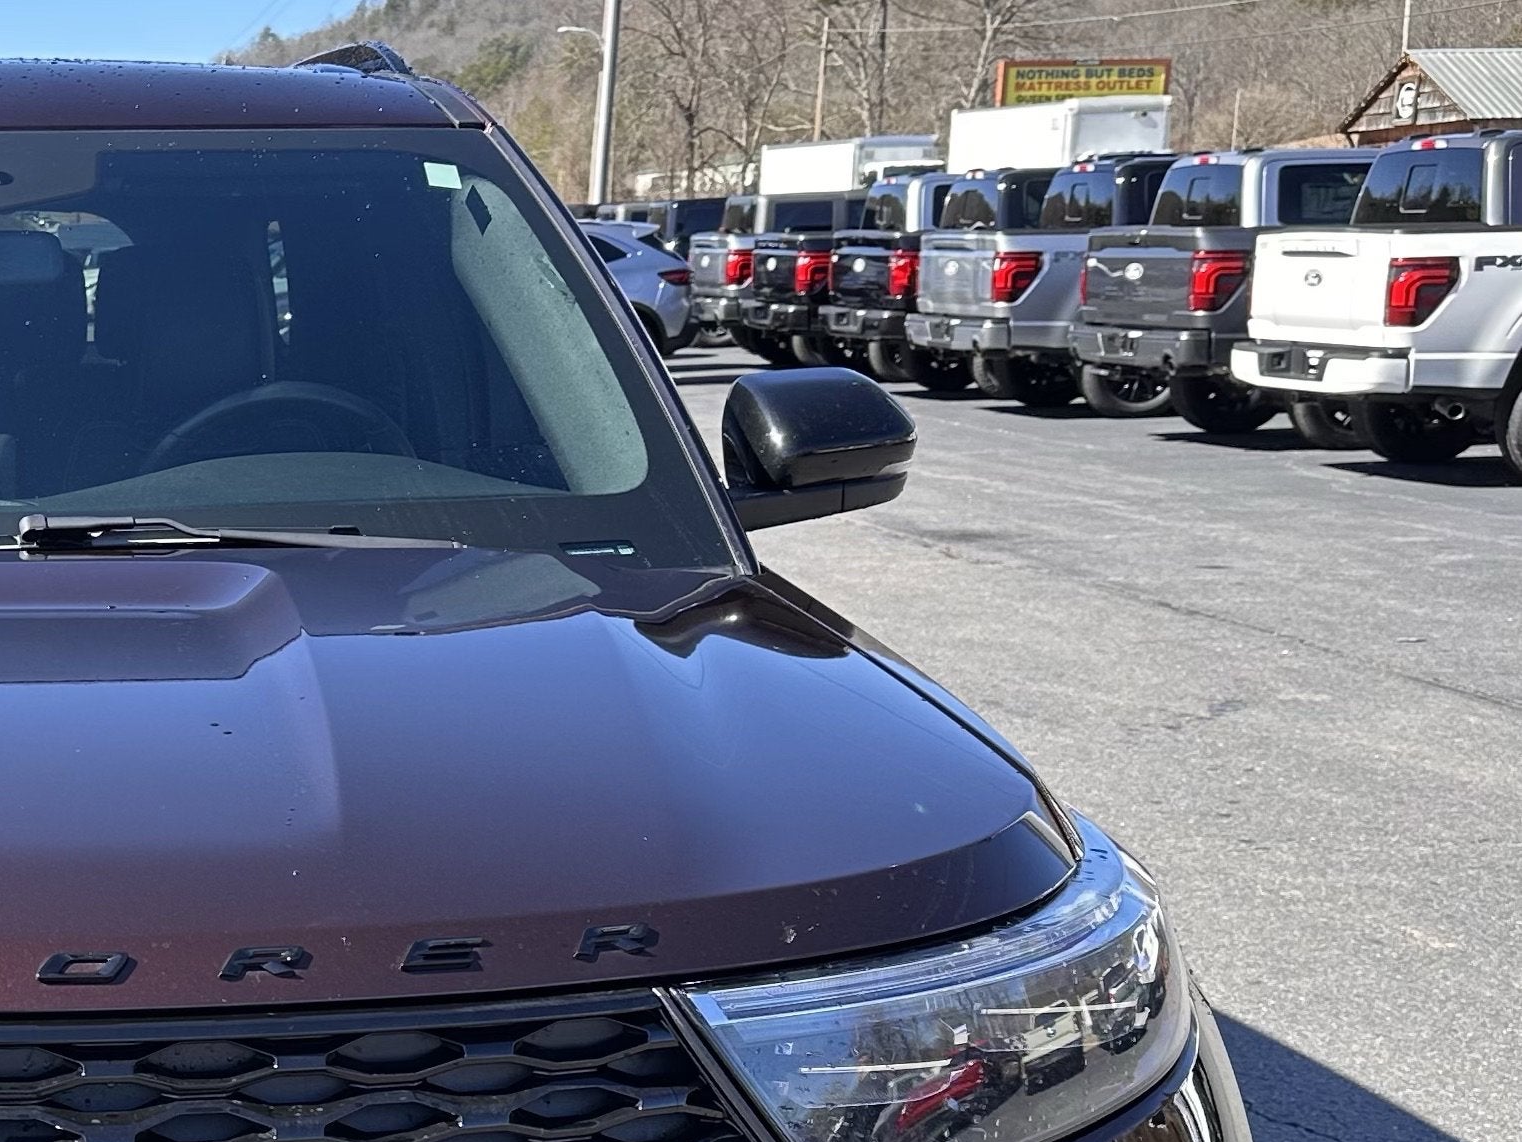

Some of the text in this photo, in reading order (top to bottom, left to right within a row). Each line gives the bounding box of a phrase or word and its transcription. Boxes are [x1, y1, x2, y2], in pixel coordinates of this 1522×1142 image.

[1016, 67, 1154, 80] NOTHING BUT BEDS
[1015, 79, 1153, 92] MATTRESS OUTLET
[1015, 94, 1052, 104] QUEEN
[1474, 255, 1522, 271] FX
